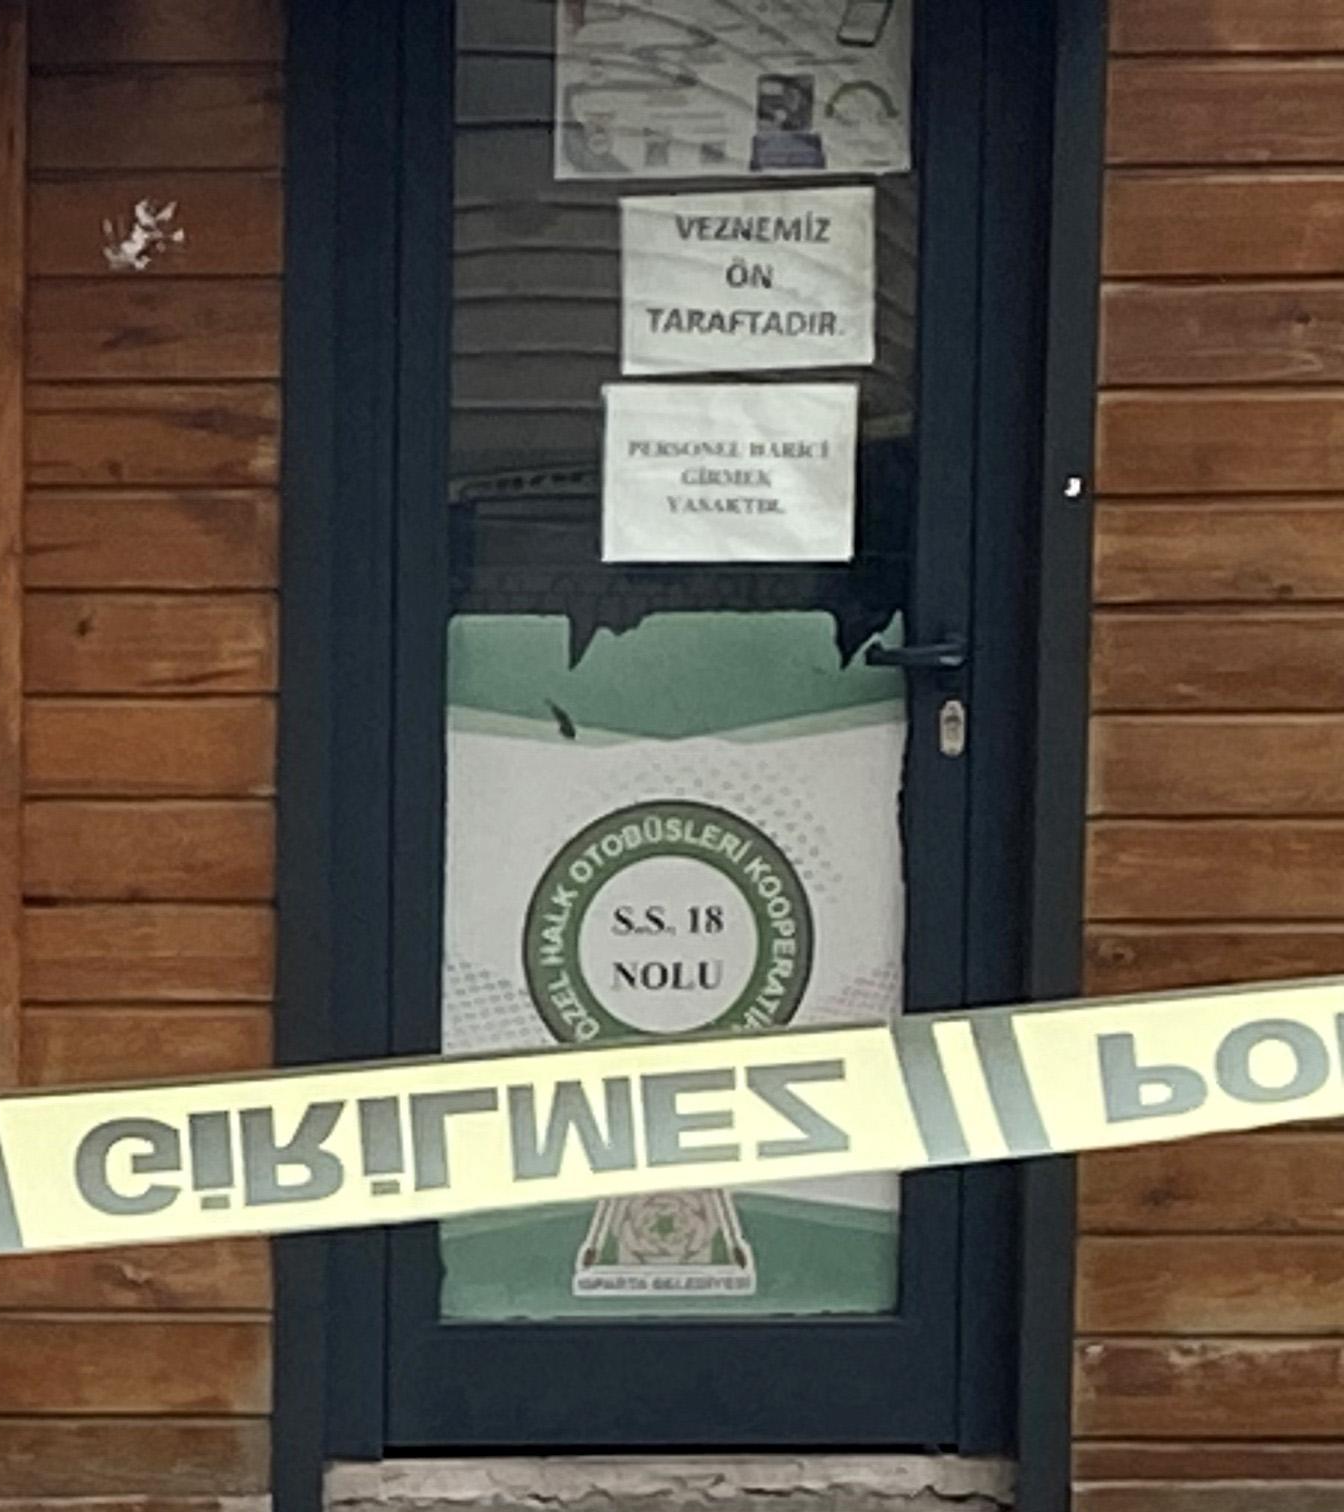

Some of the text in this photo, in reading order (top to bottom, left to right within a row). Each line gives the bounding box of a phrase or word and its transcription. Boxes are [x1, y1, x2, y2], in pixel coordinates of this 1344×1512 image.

[674, 211, 831, 243] VEZNEMİZ
[725, 256, 773, 288] ÖN
[627, 440, 739, 458] PERSONEL
[680, 466, 772, 486] GİRMEK
[539, 884, 578, 966] HALK
[611, 905, 725, 937] S.S. 18
[611, 960, 725, 991] NOLU
